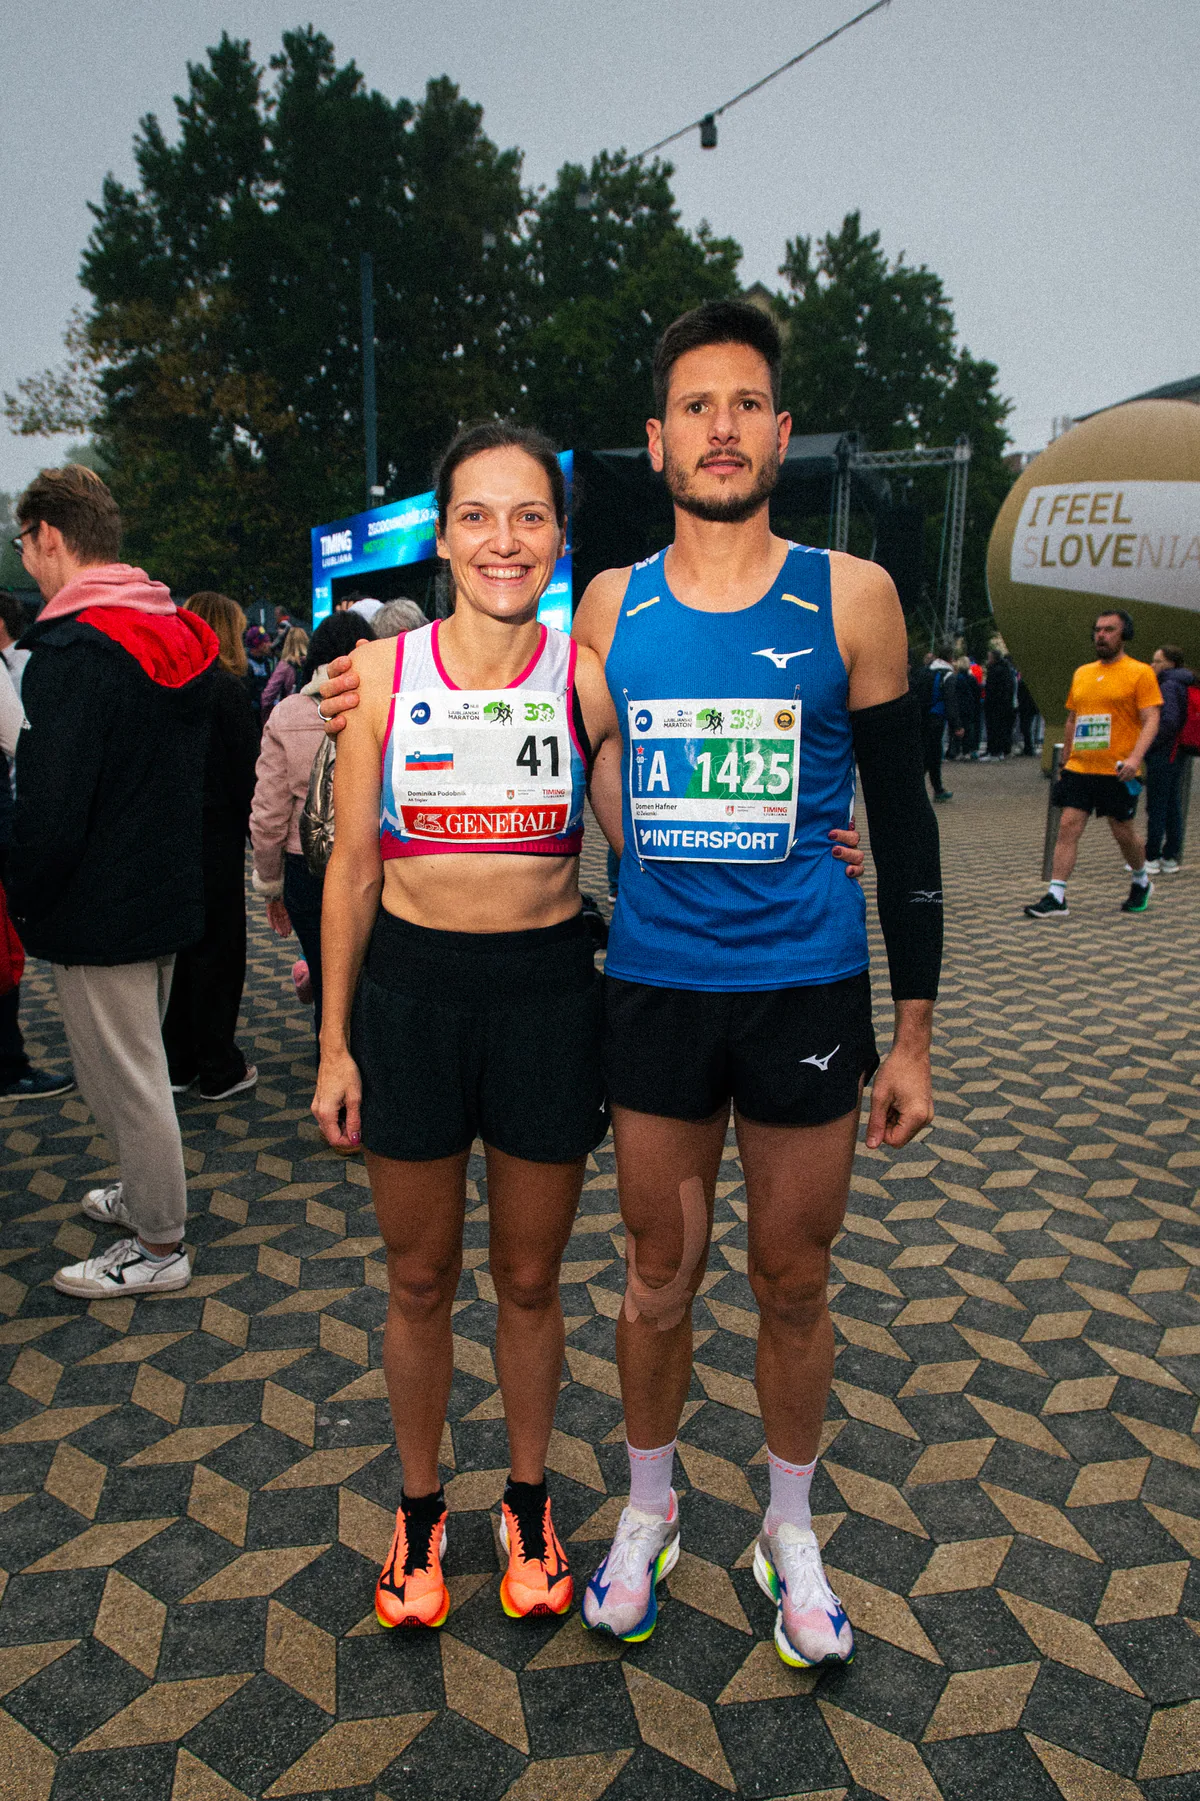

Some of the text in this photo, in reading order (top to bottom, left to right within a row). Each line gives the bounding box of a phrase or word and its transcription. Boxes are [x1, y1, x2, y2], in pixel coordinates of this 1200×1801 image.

[1027, 492, 1133, 527] I FEEL
[320, 529, 352, 556] TIMING
[1022, 533, 1200, 569] SLOVENIA
[322, 553, 353, 568] LJUBLJANA
[516, 735, 560, 777] 41
[647, 750, 790, 795] A 1425
[446, 811, 558, 834] GENERALI
[652, 829, 779, 850] INTERSPORT
